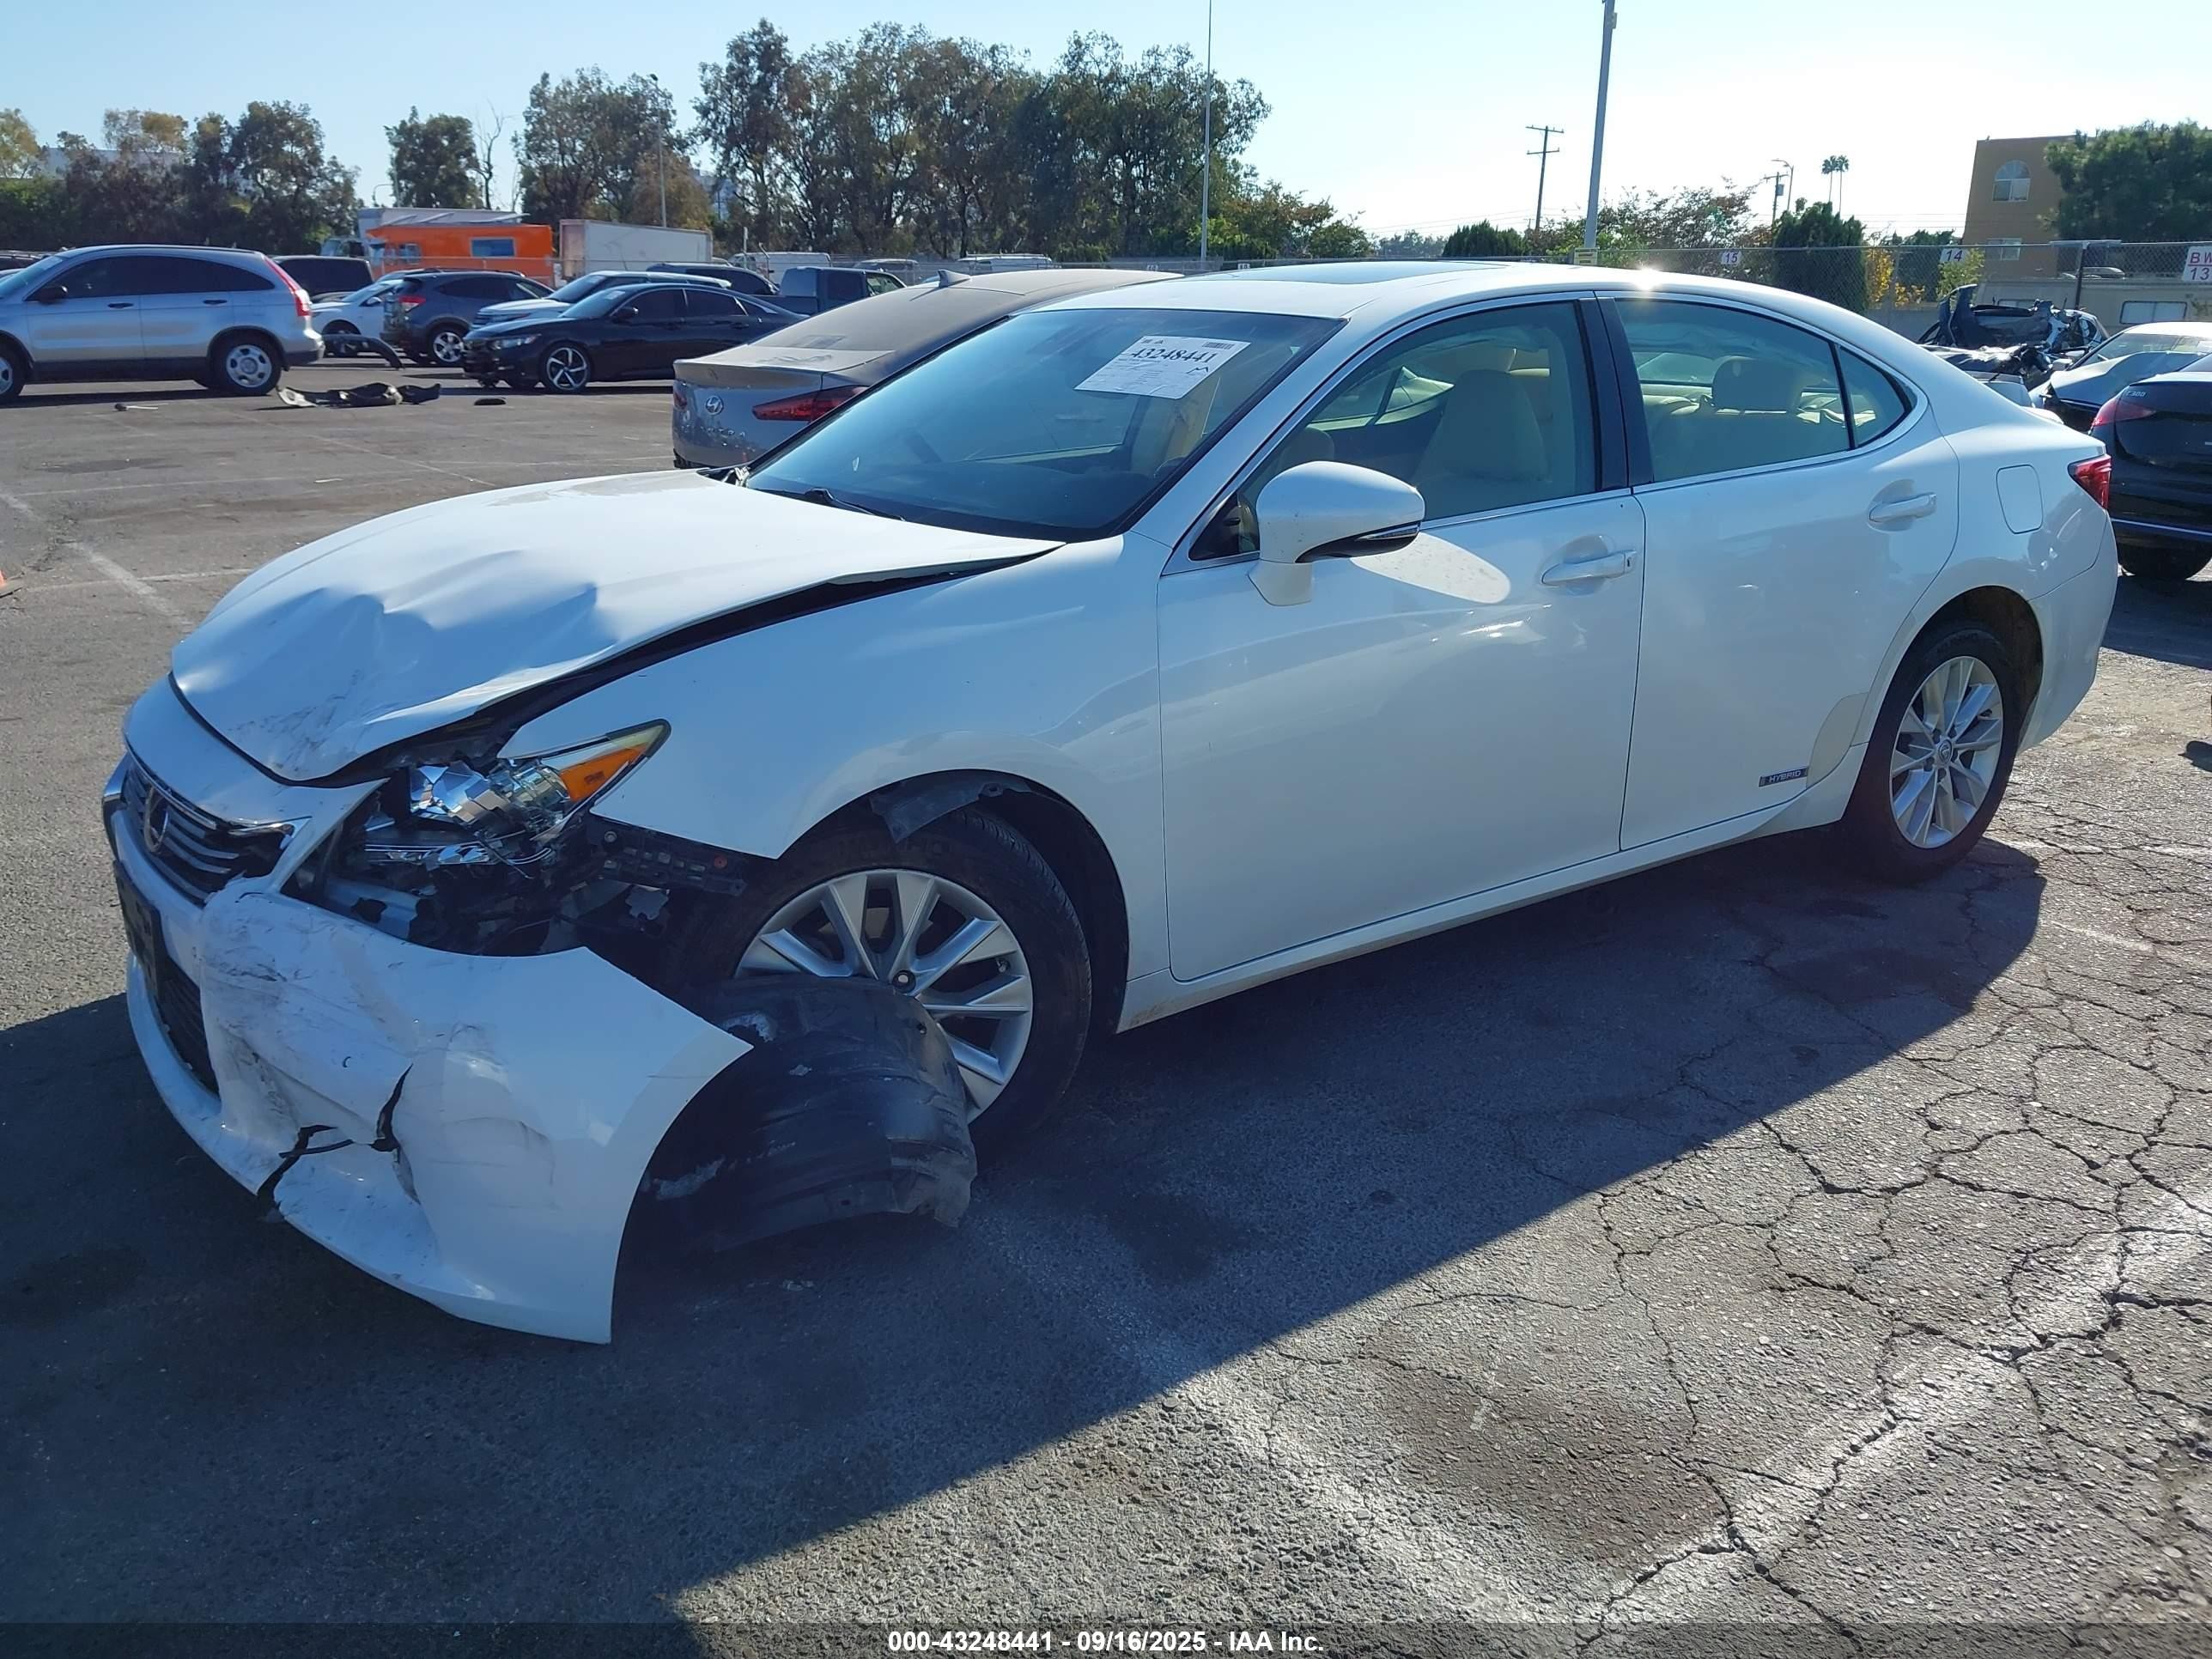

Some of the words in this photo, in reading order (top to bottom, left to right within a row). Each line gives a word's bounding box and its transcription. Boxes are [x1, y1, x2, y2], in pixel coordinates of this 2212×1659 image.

[1725, 252, 1739, 264] 15
[1946, 249, 1963, 262] 14
[2191, 267, 2210, 281] 13
[1131, 347, 1218, 363] 43248441
[1768, 769, 1802, 783] HYBRID
